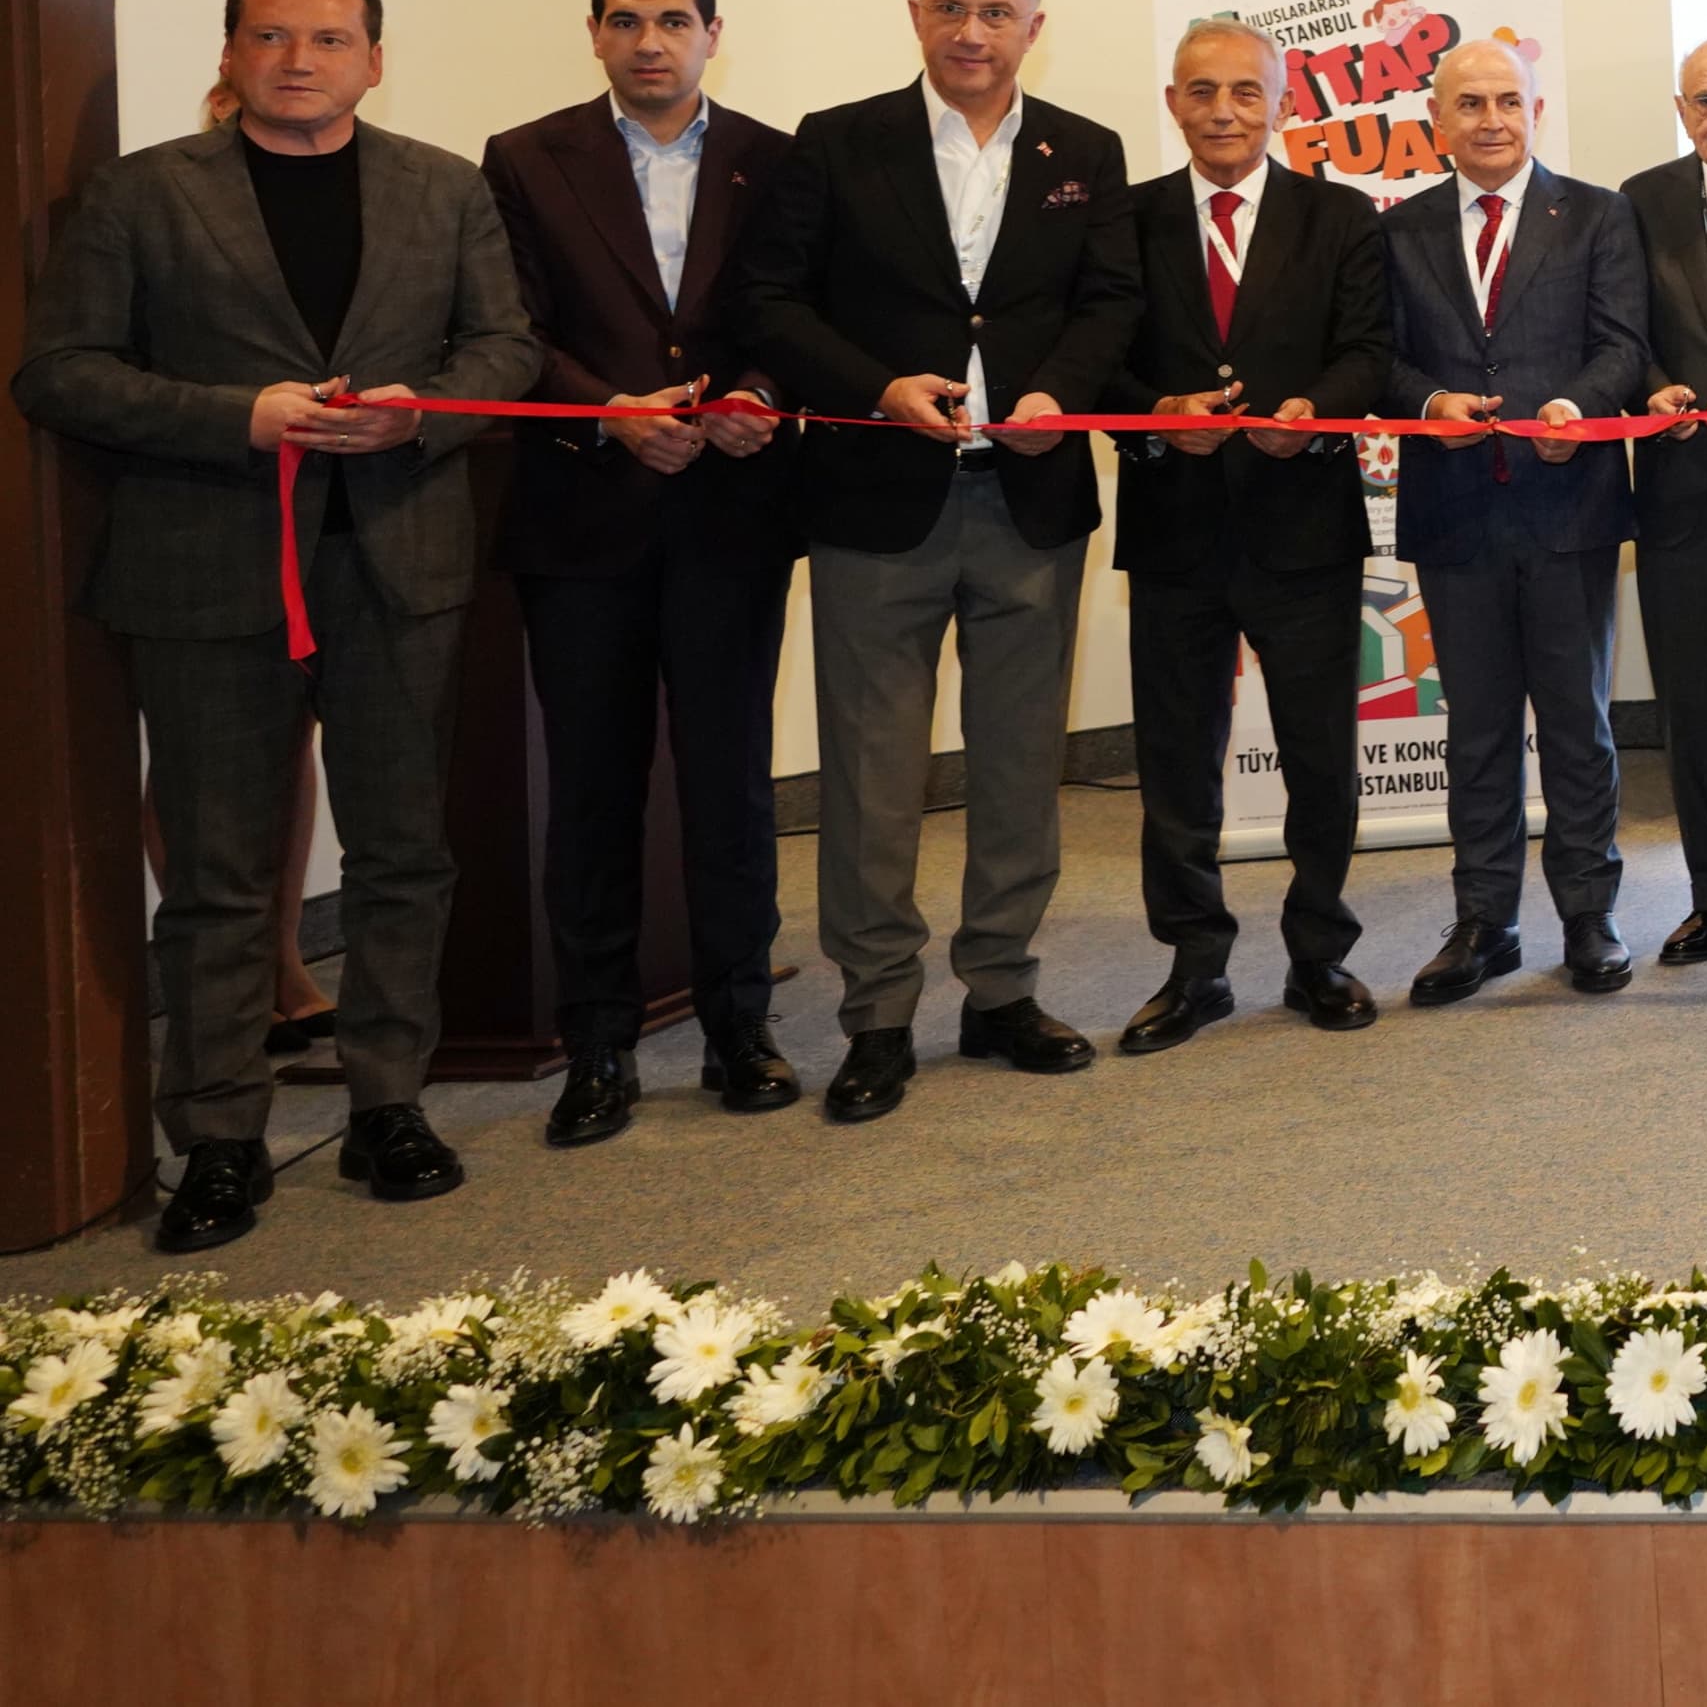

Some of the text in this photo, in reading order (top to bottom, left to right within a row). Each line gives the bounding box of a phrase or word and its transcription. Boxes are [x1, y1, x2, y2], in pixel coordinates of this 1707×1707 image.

[1267, 11, 1358, 47] STANBUL
[1284, 13, 1460, 123] İTAP
[1363, 744, 1388, 765] VE
[1395, 740, 1449, 763] KONG
